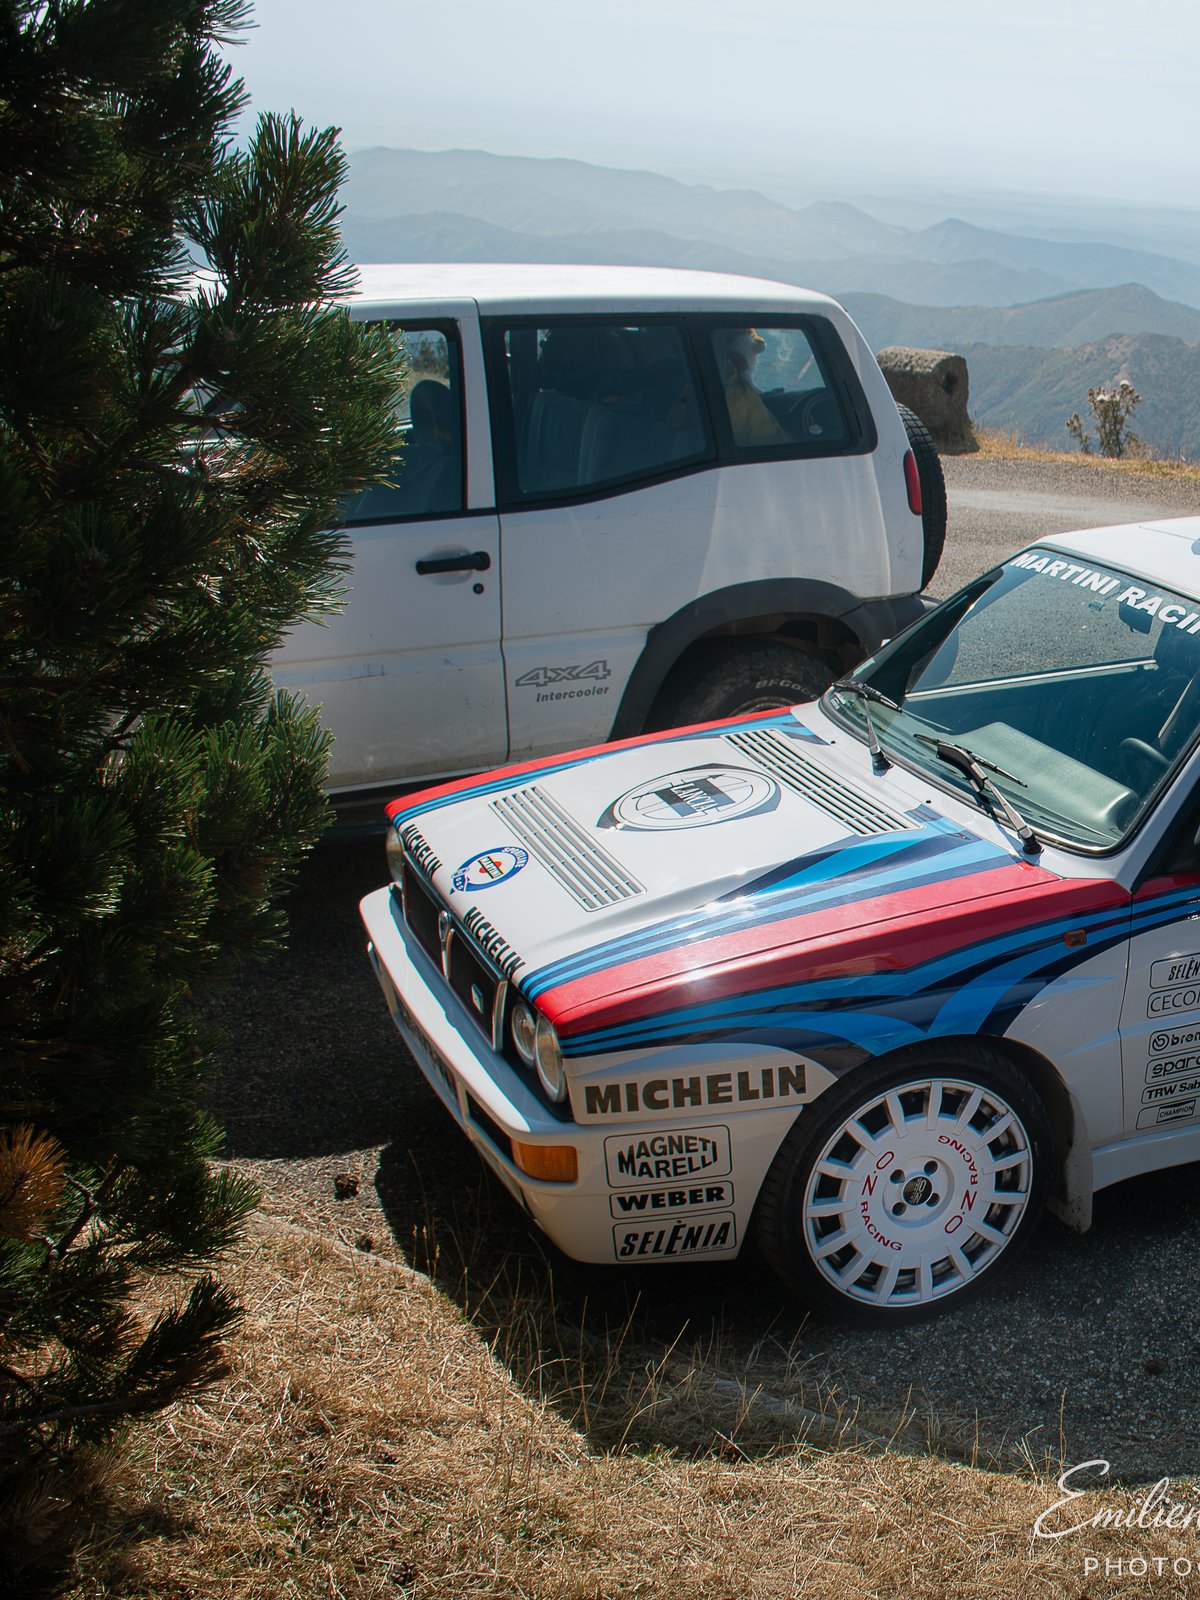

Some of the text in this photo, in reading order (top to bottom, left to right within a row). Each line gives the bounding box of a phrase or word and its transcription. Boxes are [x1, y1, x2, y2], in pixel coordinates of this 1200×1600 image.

[1010, 552, 1121, 595] MARTINI
[515, 660, 611, 687] 4x4
[536, 686, 610, 703] Intercooler
[671, 782, 719, 815] LANCIA
[402, 824, 443, 879] MICHELIN
[463, 906, 526, 977] MICHELIN
[585, 1064, 807, 1115] MICHELIN
[1146, 1085, 1177, 1100] TRW
[1159, 1104, 1195, 1119] CHAMPION
[617, 1148, 718, 1179] MARELLI
[938, 1135, 978, 1185] RACING
[617, 1186, 725, 1212] WEBER
[860, 1201, 903, 1251] RACING
